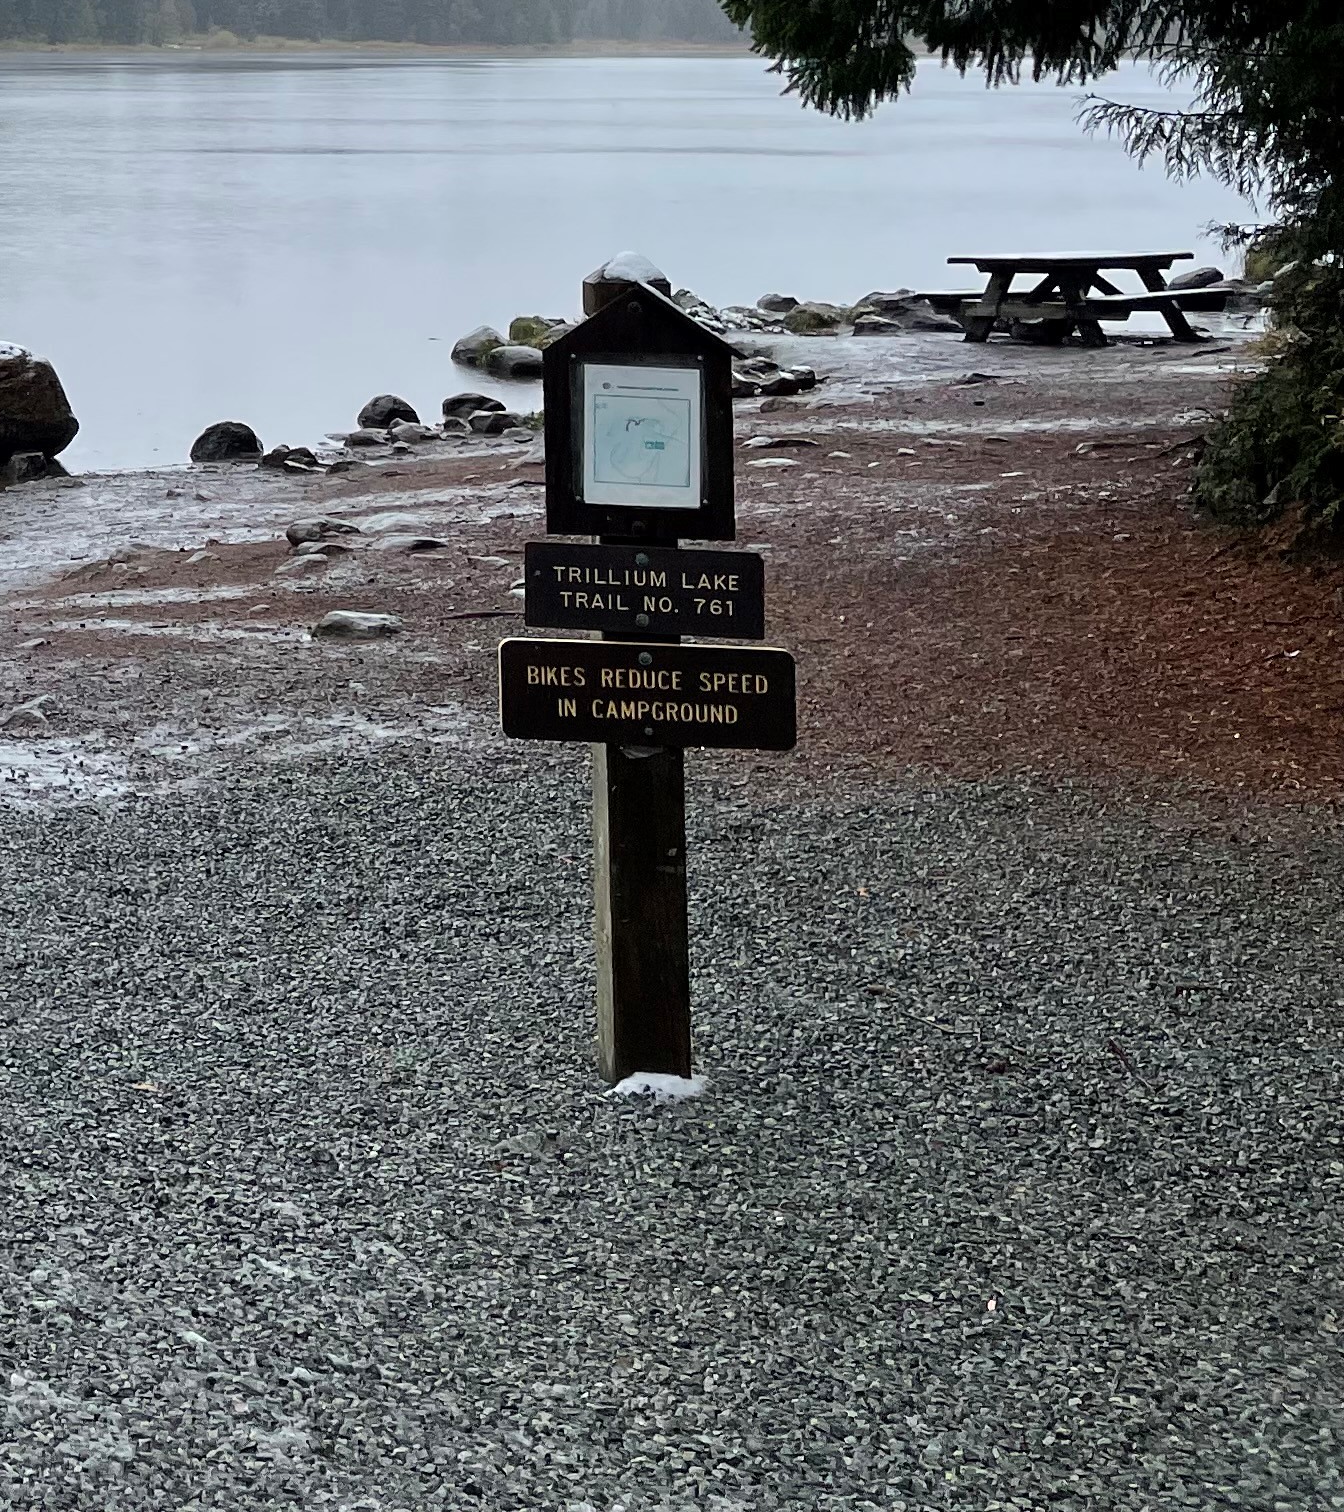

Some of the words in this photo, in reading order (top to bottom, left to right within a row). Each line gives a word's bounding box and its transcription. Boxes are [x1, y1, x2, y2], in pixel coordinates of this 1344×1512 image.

[553, 566, 667, 588] TRILLIUM
[681, 574, 740, 591] LAKE
[560, 591, 629, 611] TRAIL
[643, 596, 679, 614] NO.
[693, 598, 734, 616] 761
[527, 665, 586, 687] BIKES
[601, 668, 683, 691] REDUCE
[699, 672, 768, 694] SPEED
[558, 698, 577, 717] IN
[592, 699, 739, 724] CAMPGROUND
